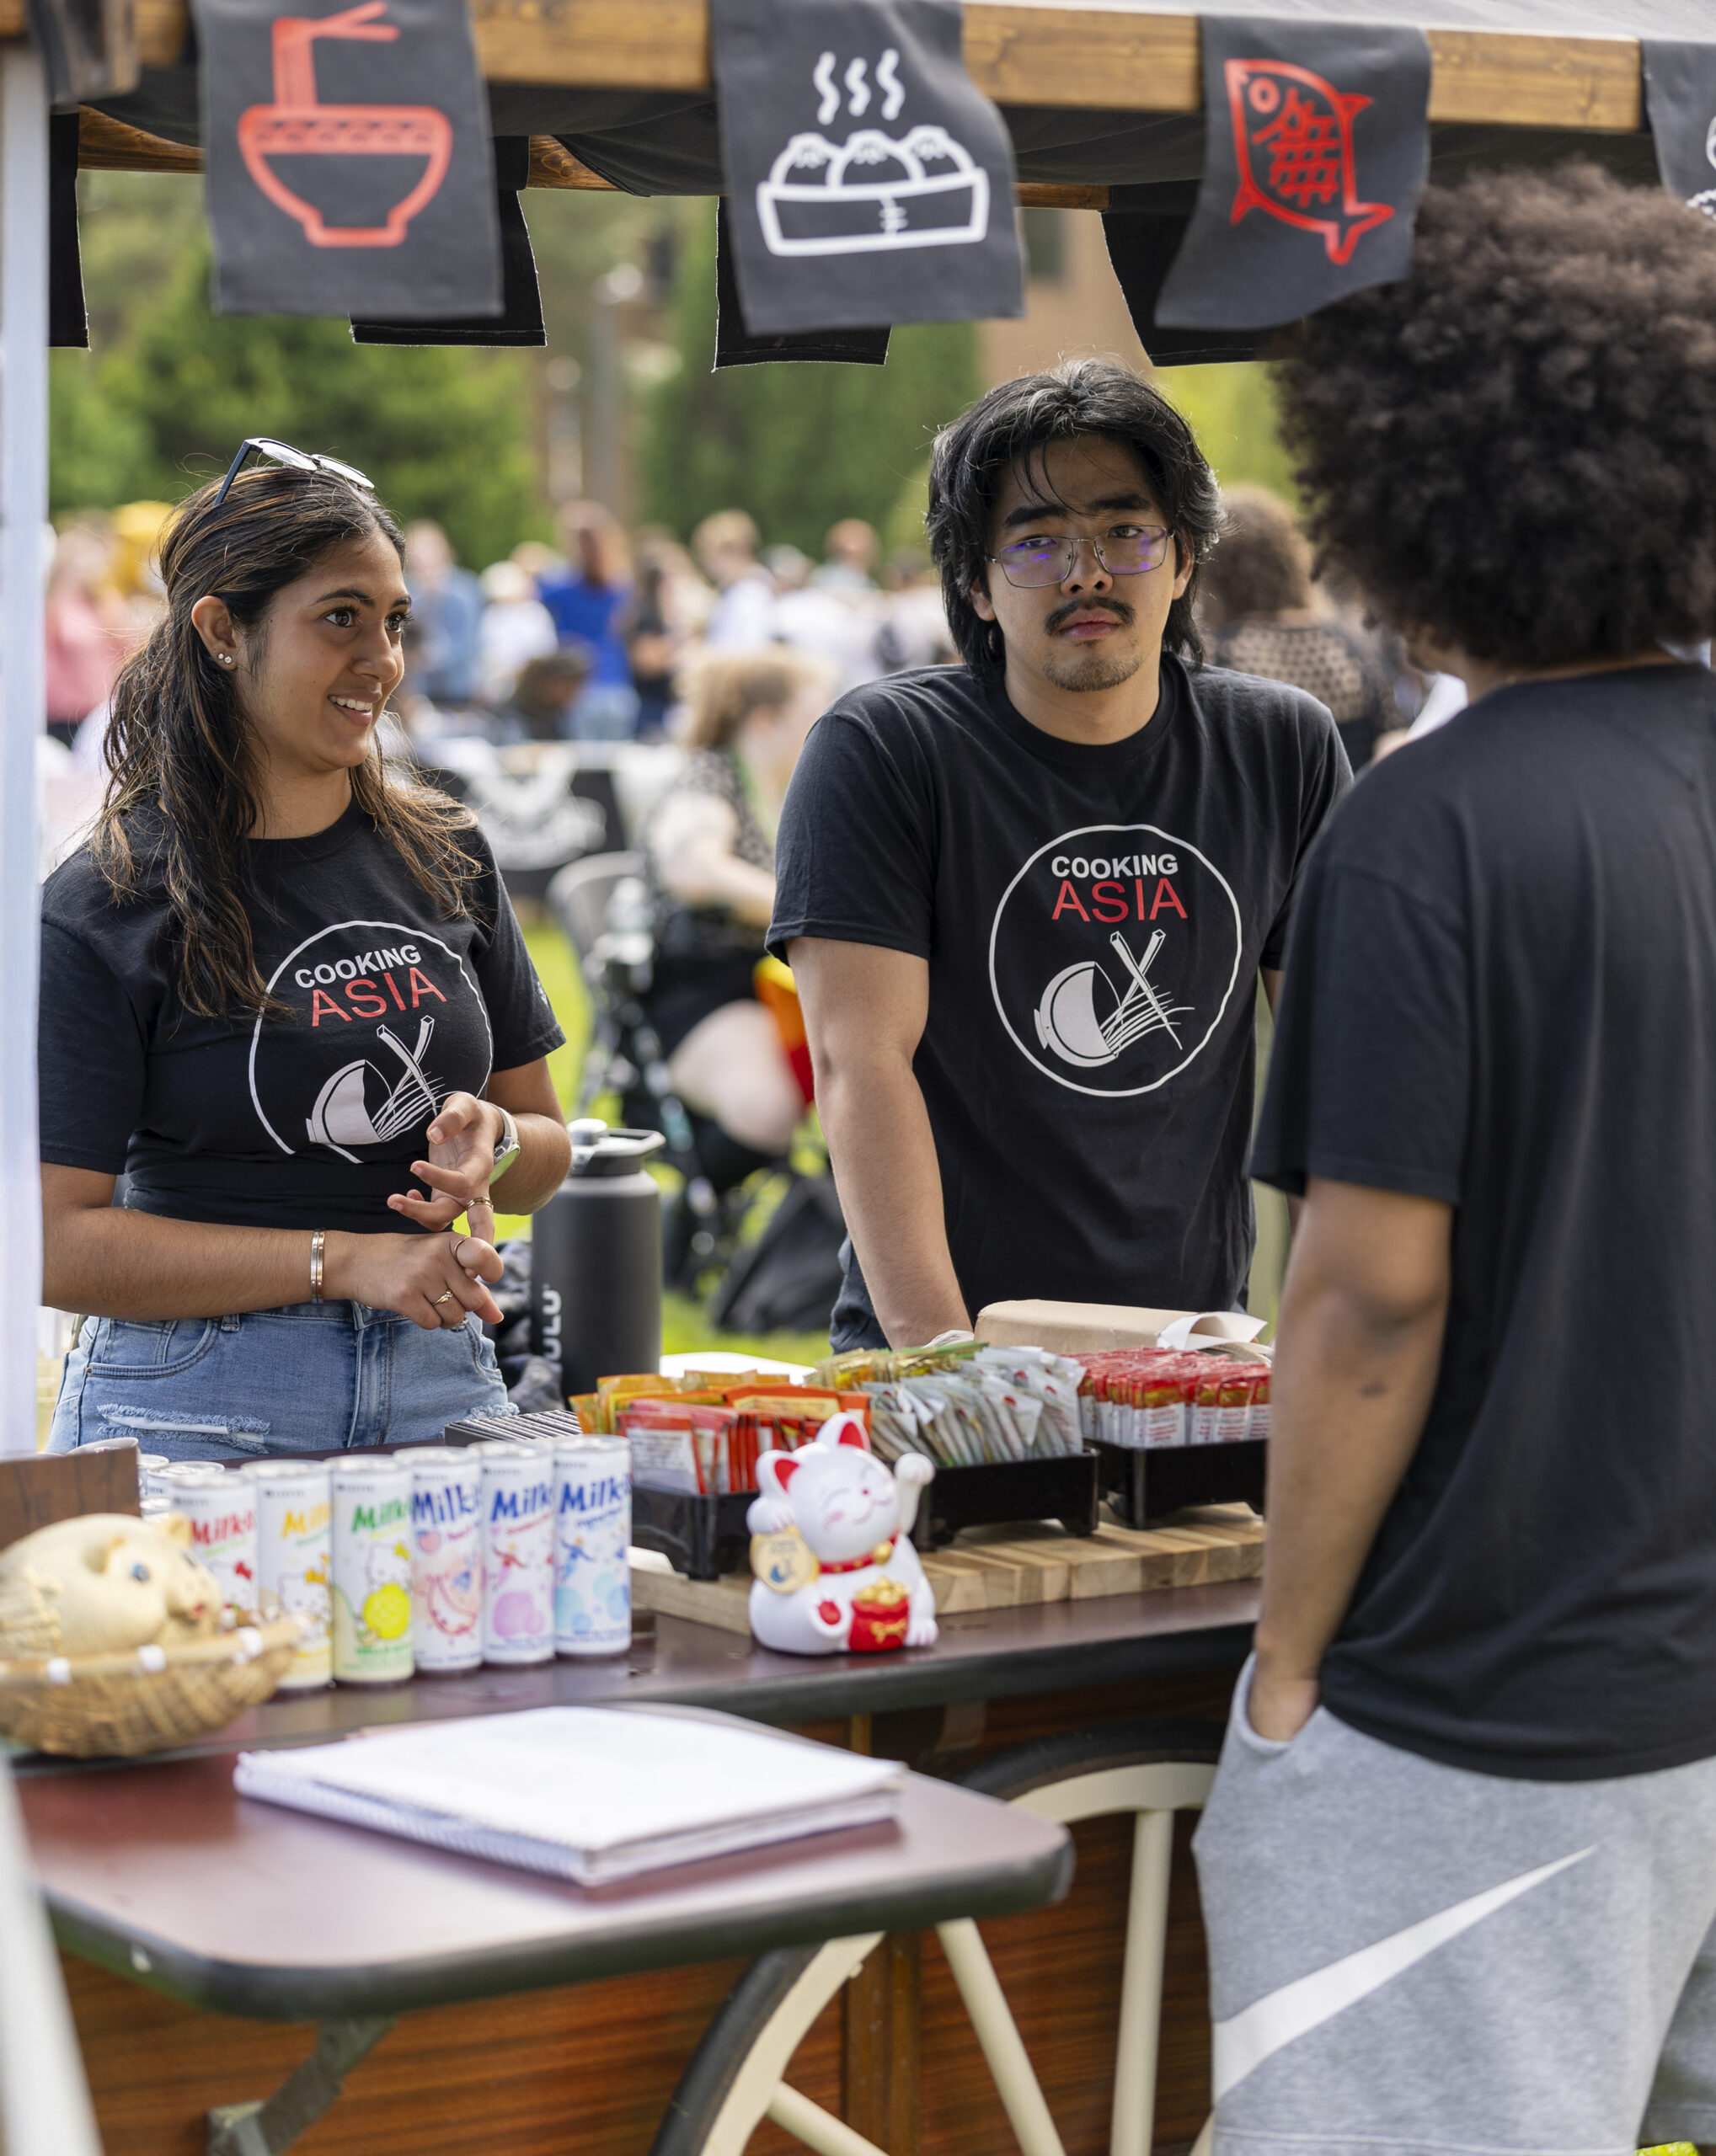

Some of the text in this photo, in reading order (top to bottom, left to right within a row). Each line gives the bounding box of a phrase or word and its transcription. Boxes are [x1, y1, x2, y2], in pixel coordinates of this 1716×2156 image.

[1051, 853, 1179, 878] COOKING
[1051, 878, 1188, 923] ASIA
[295, 944, 421, 989] COOKING
[311, 967, 447, 1027] ASIA
[542, 1289, 562, 1369] ULU
[351, 1495, 411, 1534] Milk
[489, 1481, 552, 1522] Milk
